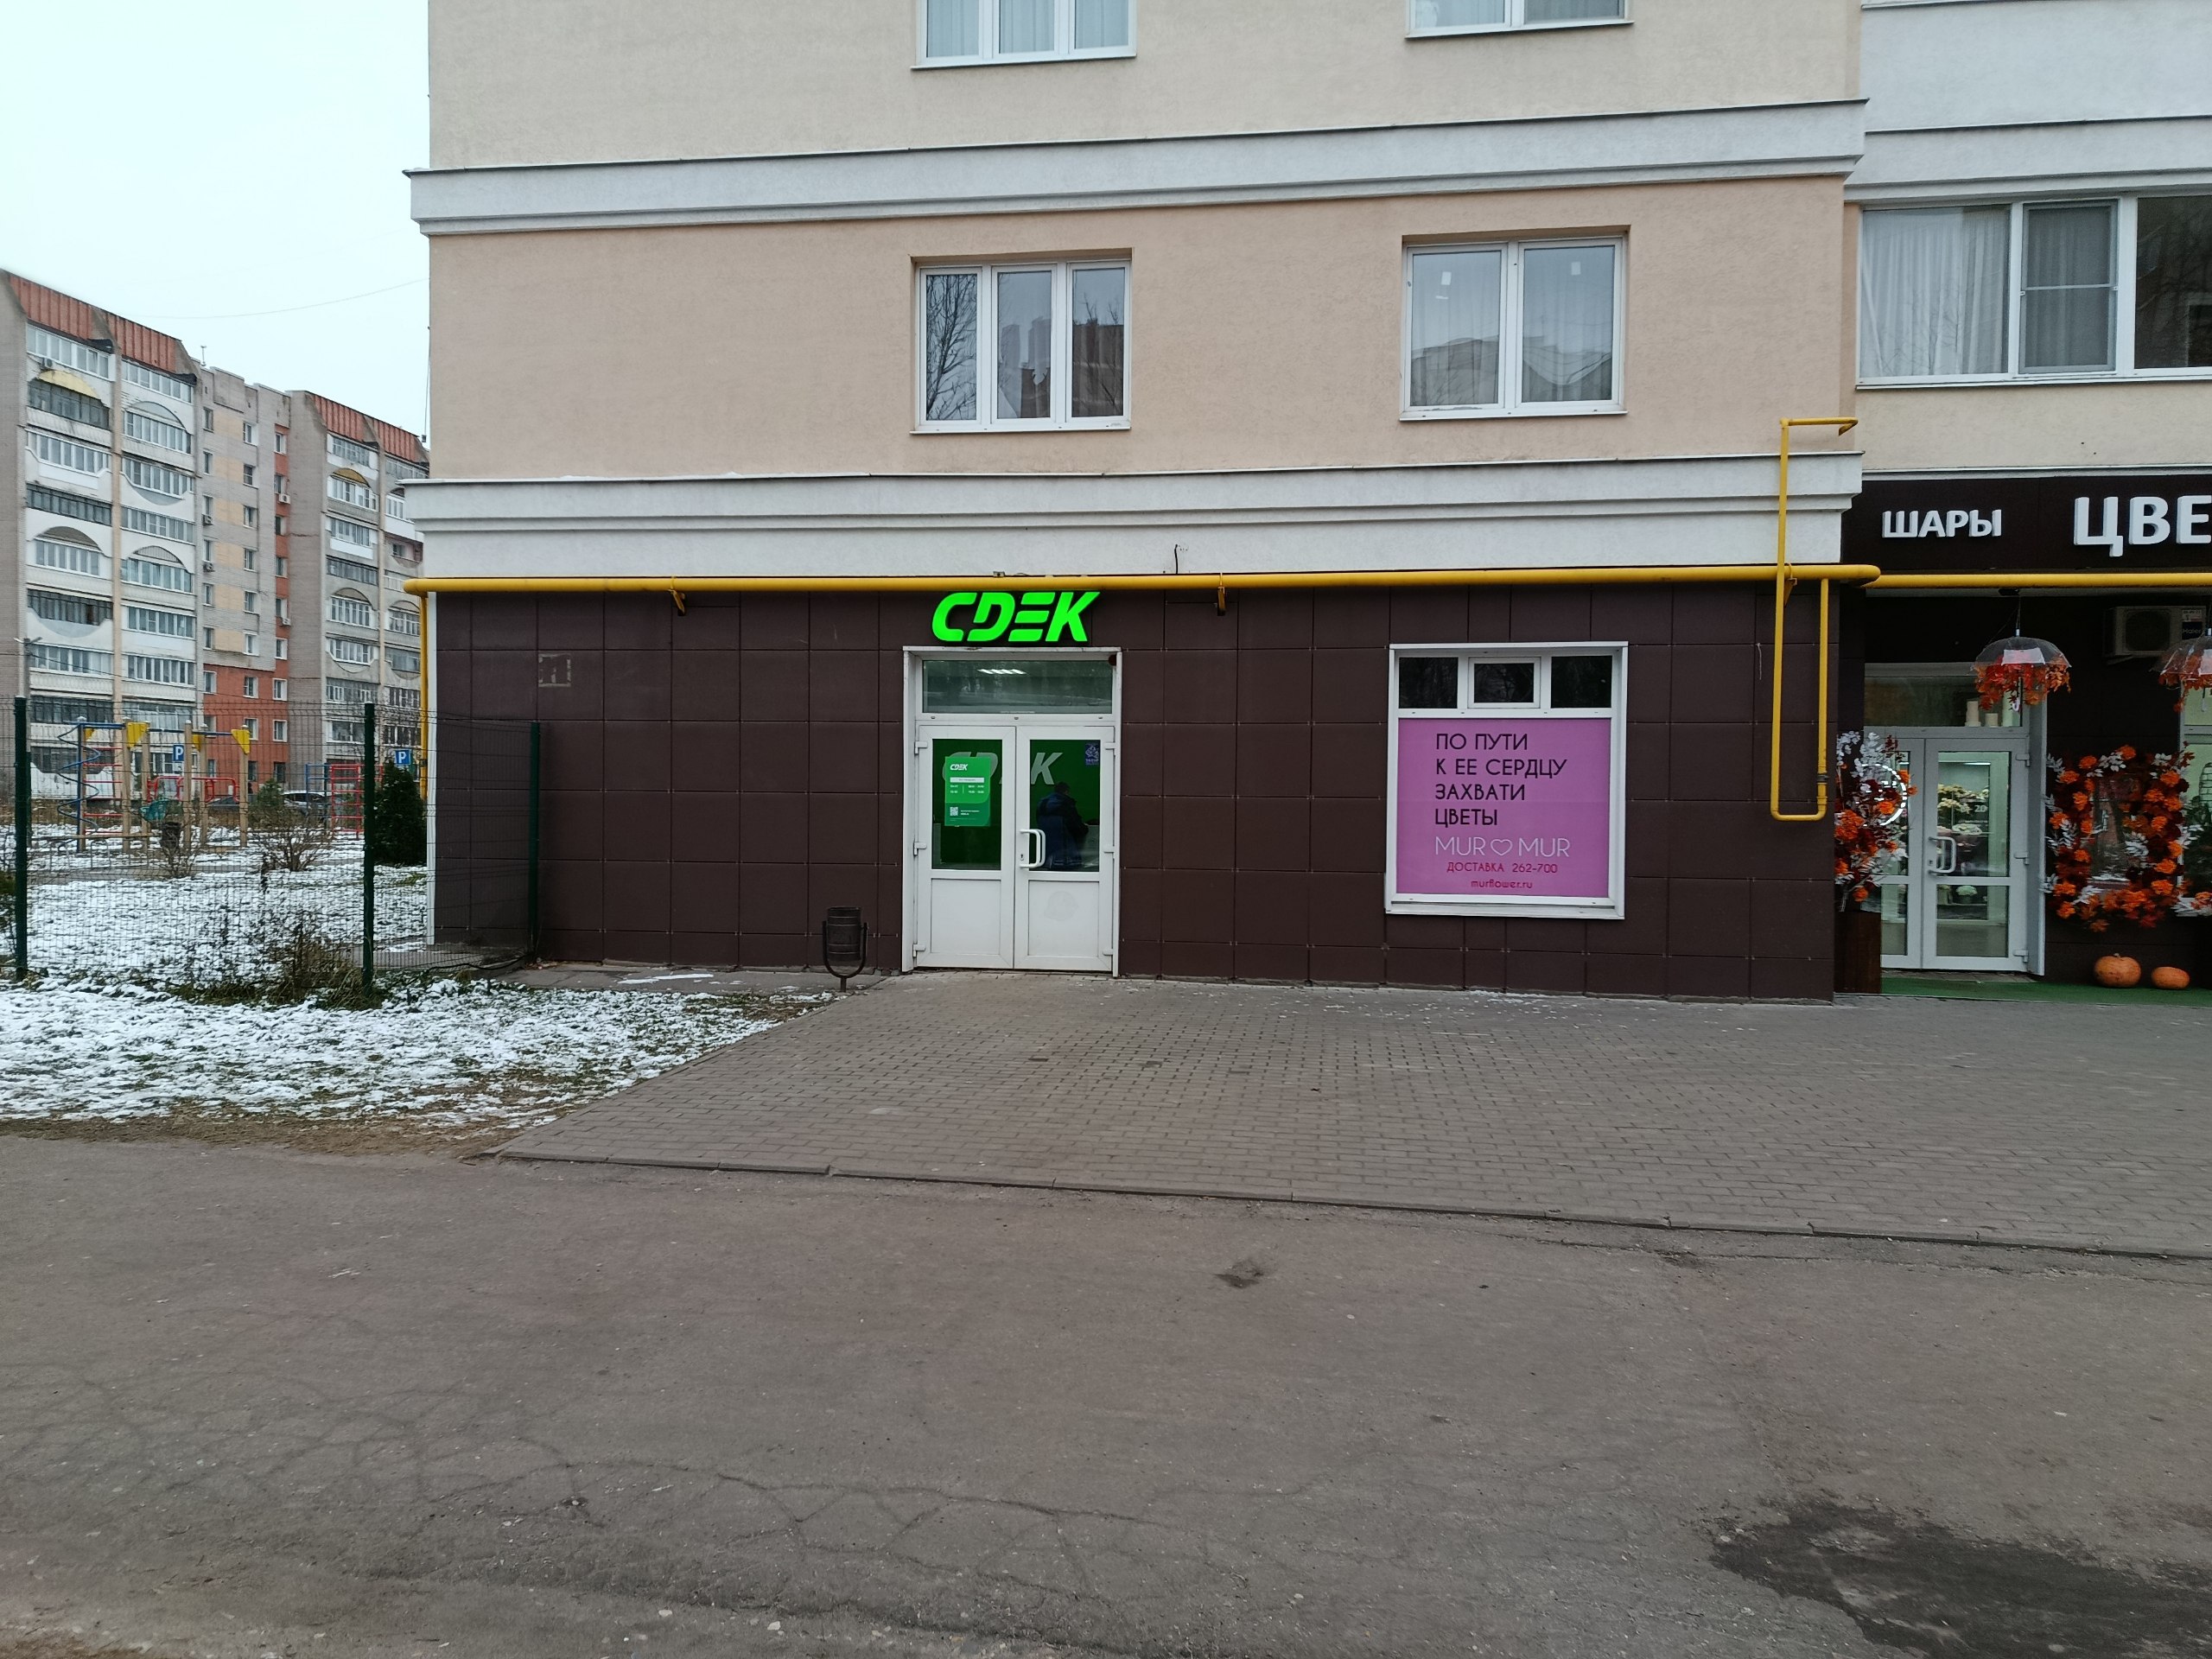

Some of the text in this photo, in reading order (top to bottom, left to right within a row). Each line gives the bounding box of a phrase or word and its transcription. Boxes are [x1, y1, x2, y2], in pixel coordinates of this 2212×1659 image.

[1882, 509, 2002, 538] ШАРЫ
[2074, 495, 2212, 557] ЦВЕ
[931, 591, 1101, 642] CDEK
[1436, 733, 1528, 750] ПО ПУТИ
[398, 751, 407, 764] P
[1436, 758, 1567, 779] К ЕЕ СЕРДЦУ
[1434, 784, 1525, 800] ЗАХВАТИ
[1434, 808, 1497, 828] ЦВЕТЫ
[1435, 836, 1571, 857] MUR MUR
[1446, 861, 1558, 874] ДОСТАВКА 262-700
[1471, 879, 1533, 888] murflower.ru
